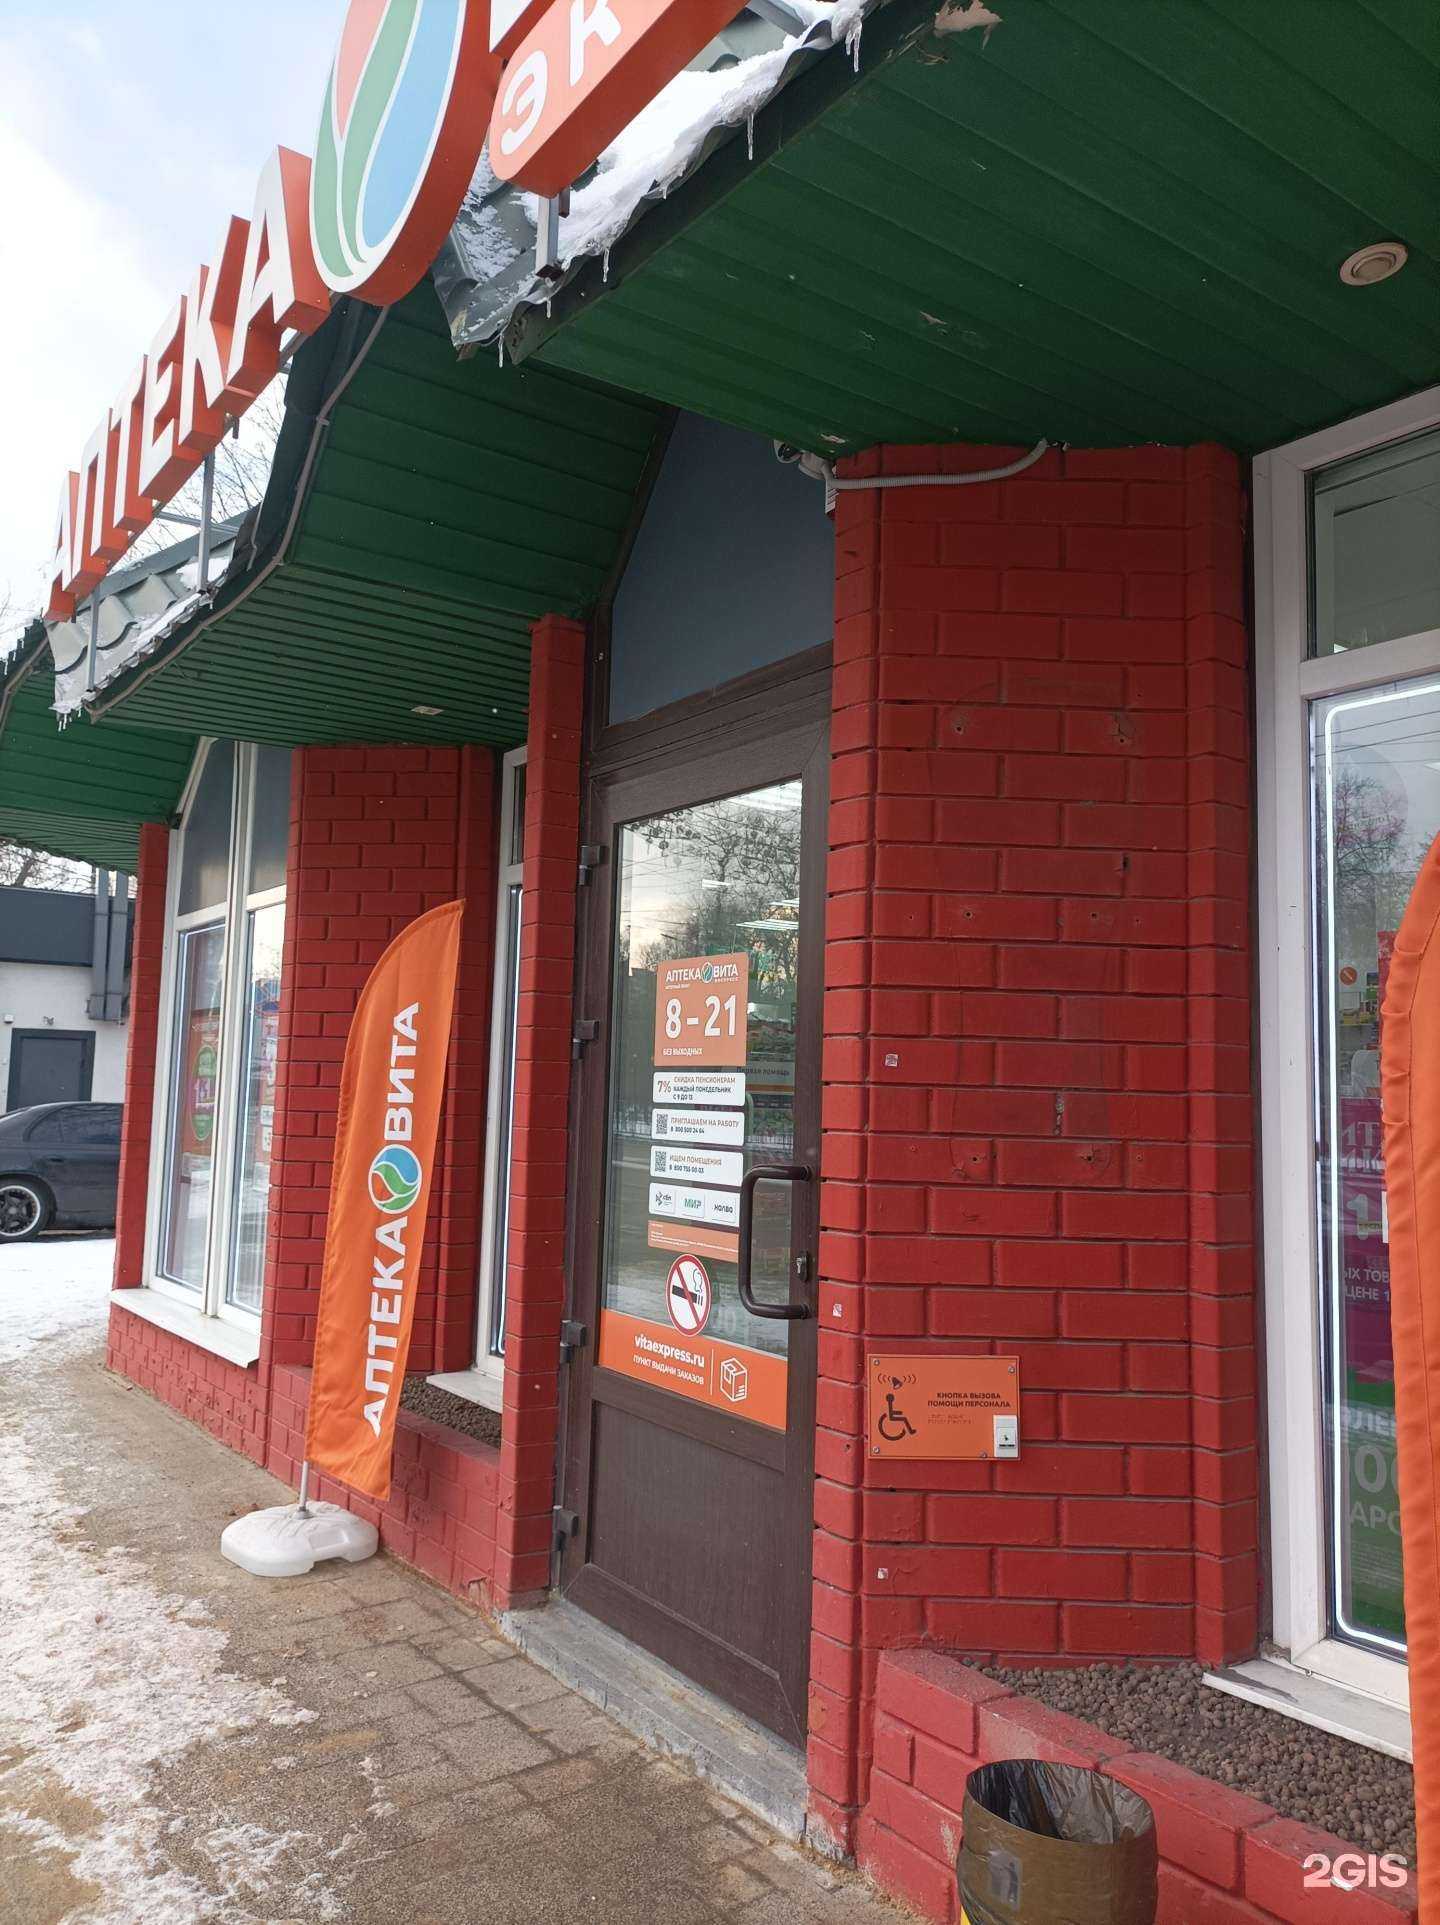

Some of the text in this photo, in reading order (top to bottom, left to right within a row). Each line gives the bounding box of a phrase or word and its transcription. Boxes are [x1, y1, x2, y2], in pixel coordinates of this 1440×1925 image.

[47, 145, 312, 613] АПТЕКА
[666, 963, 739, 982] АПТЕКА ВИТА
[665, 998, 682, 1039] 8
[704, 994, 736, 1037] 21
[663, 1047, 703, 1057] БЕЗ ВЫХОДНЫХ
[658, 1080, 672, 1093] 7%
[673, 1076, 736, 1085] СКИДКА ПЕНСИОНЕРАМ
[695, 1086, 732, 1094] ПОНЕДЕЛЬНИК
[670, 1117, 707, 1126] ПРИГЛАШАЕМ
[717, 1119, 740, 1128] РАБОТУ
[669, 1154, 722, 1166] ИЩЕМ ПОМЕЩЕНИЯ
[684, 1197, 702, 1209] МИР
[363, 1001, 420, 1439] АПТЕКА ВИТА
[634, 1333, 705, 1368] vitaexpress.ru
[633, 1354, 705, 1385] ПУНКТ ВЫДАЧИ ЗАКАЗОВ
[927, 1400, 1011, 1409] ПОМОЩИ ПЕРСОНАЛА
